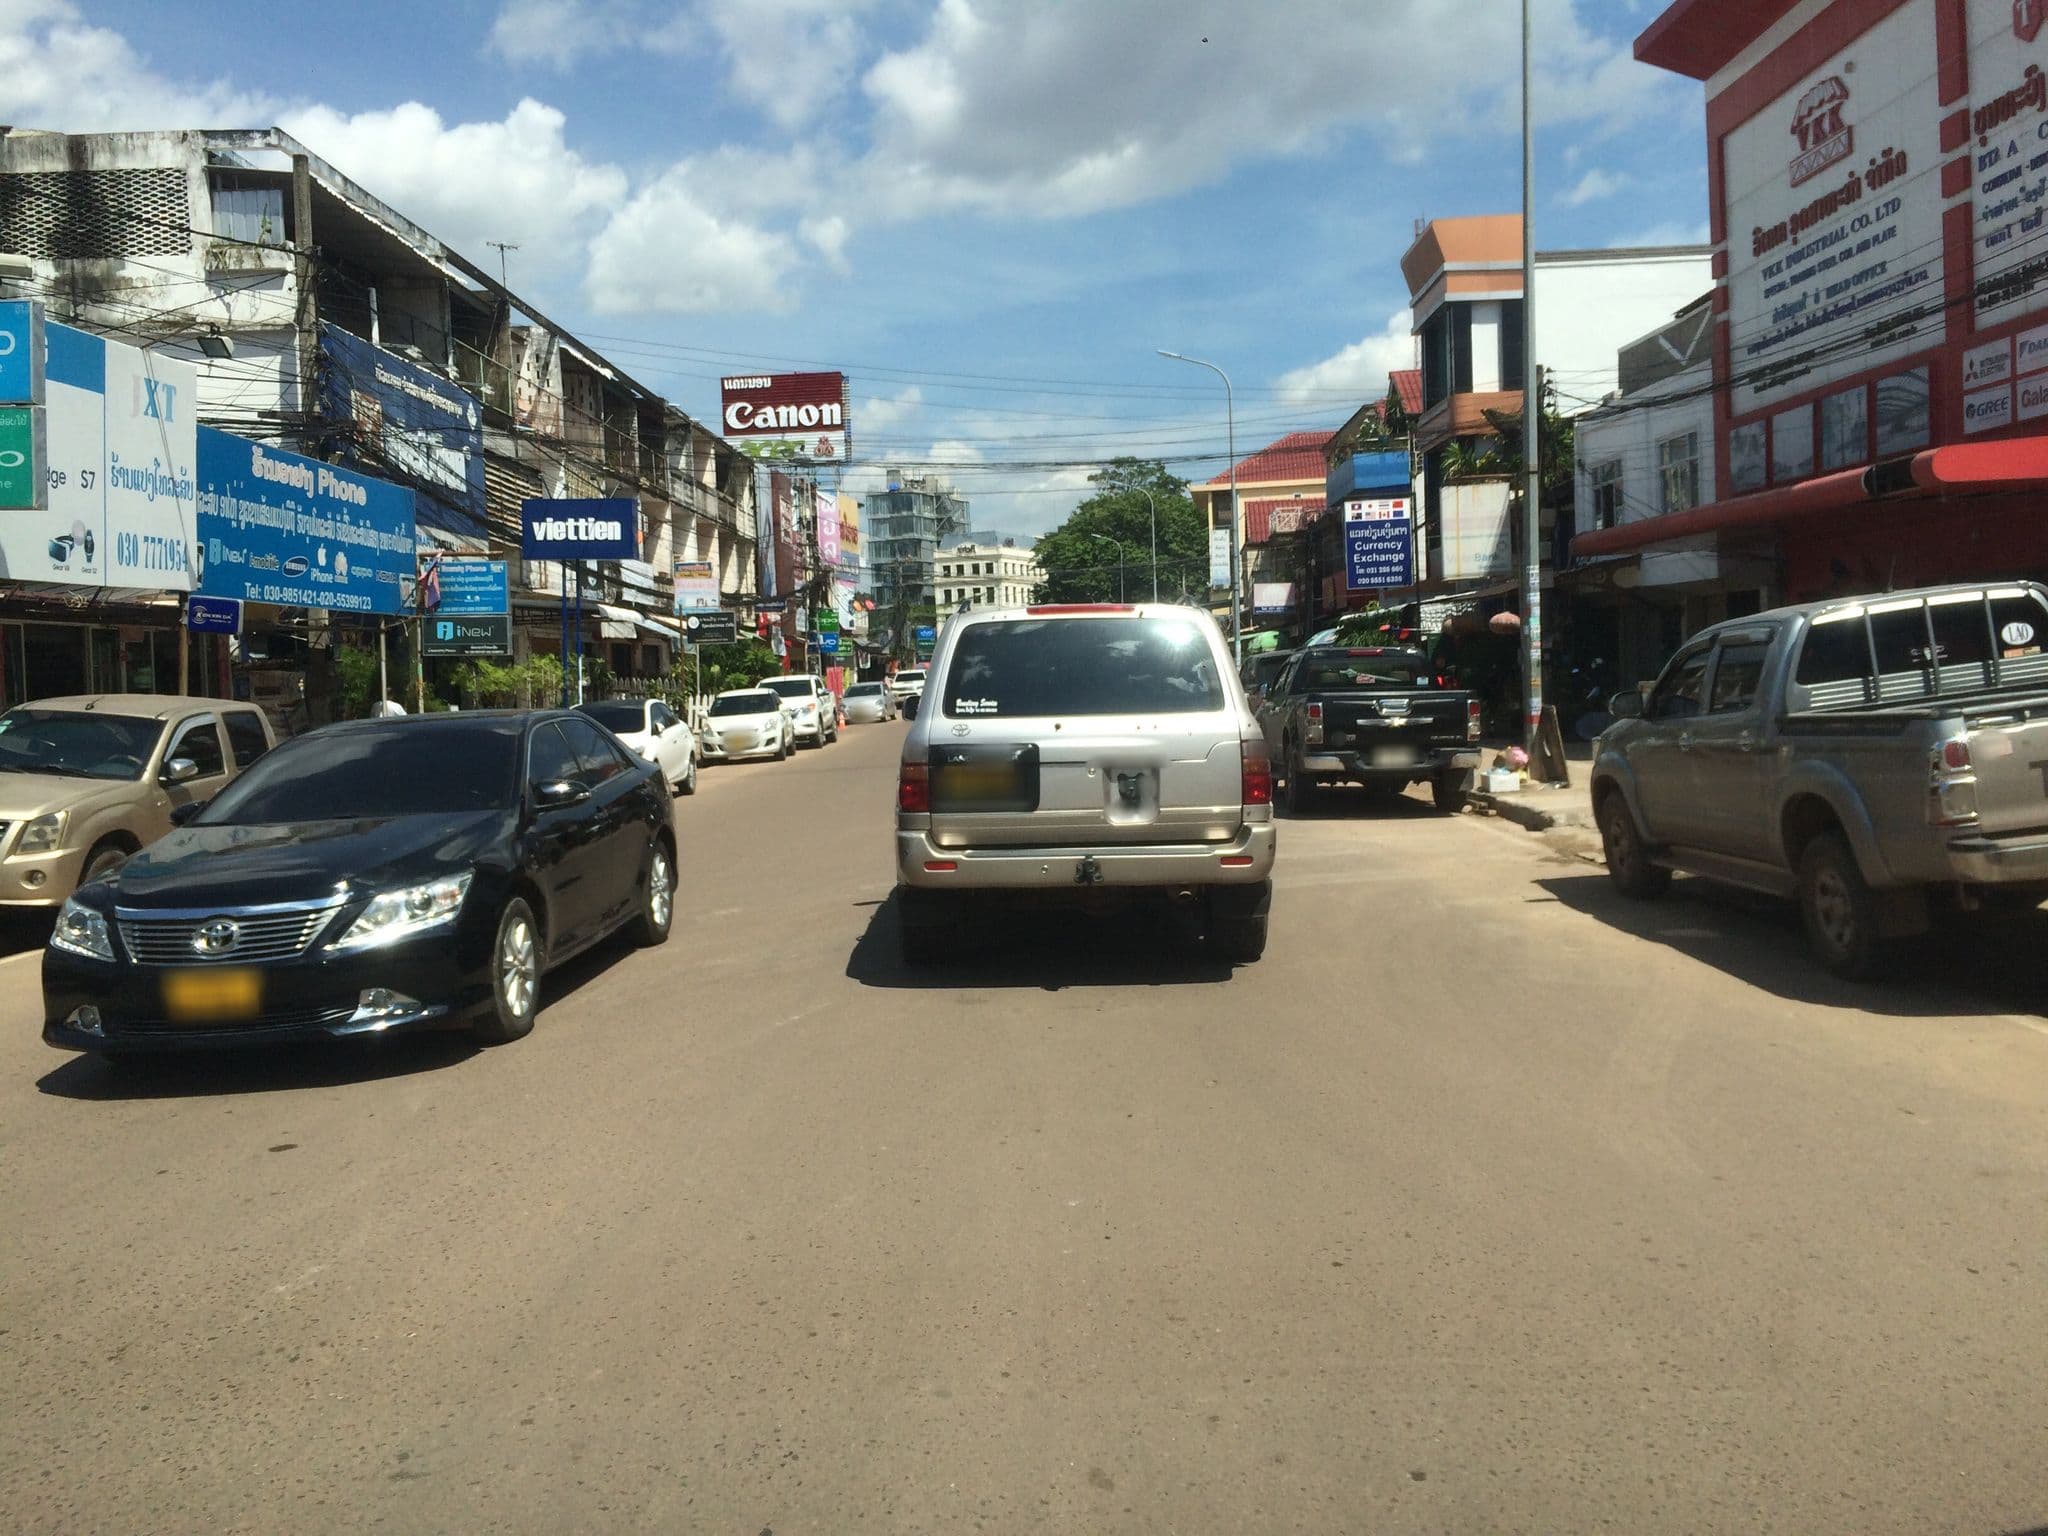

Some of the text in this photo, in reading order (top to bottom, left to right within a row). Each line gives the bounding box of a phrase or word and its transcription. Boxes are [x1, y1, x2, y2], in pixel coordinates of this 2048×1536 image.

[1785, 226, 1848, 270] INDUSTRIAL
[726, 401, 842, 430] Canon
[1977, 396, 2009, 417] GREE
[80, 470, 95, 490] S7
[318, 467, 367, 506] Phone
[532, 517, 621, 541] viettien
[117, 531, 139, 567] 030
[1355, 541, 1402, 551] Currency
[1353, 553, 1405, 563] Exchange
[311, 567, 334, 584] iPhone
[244, 581, 262, 599] Tel:
